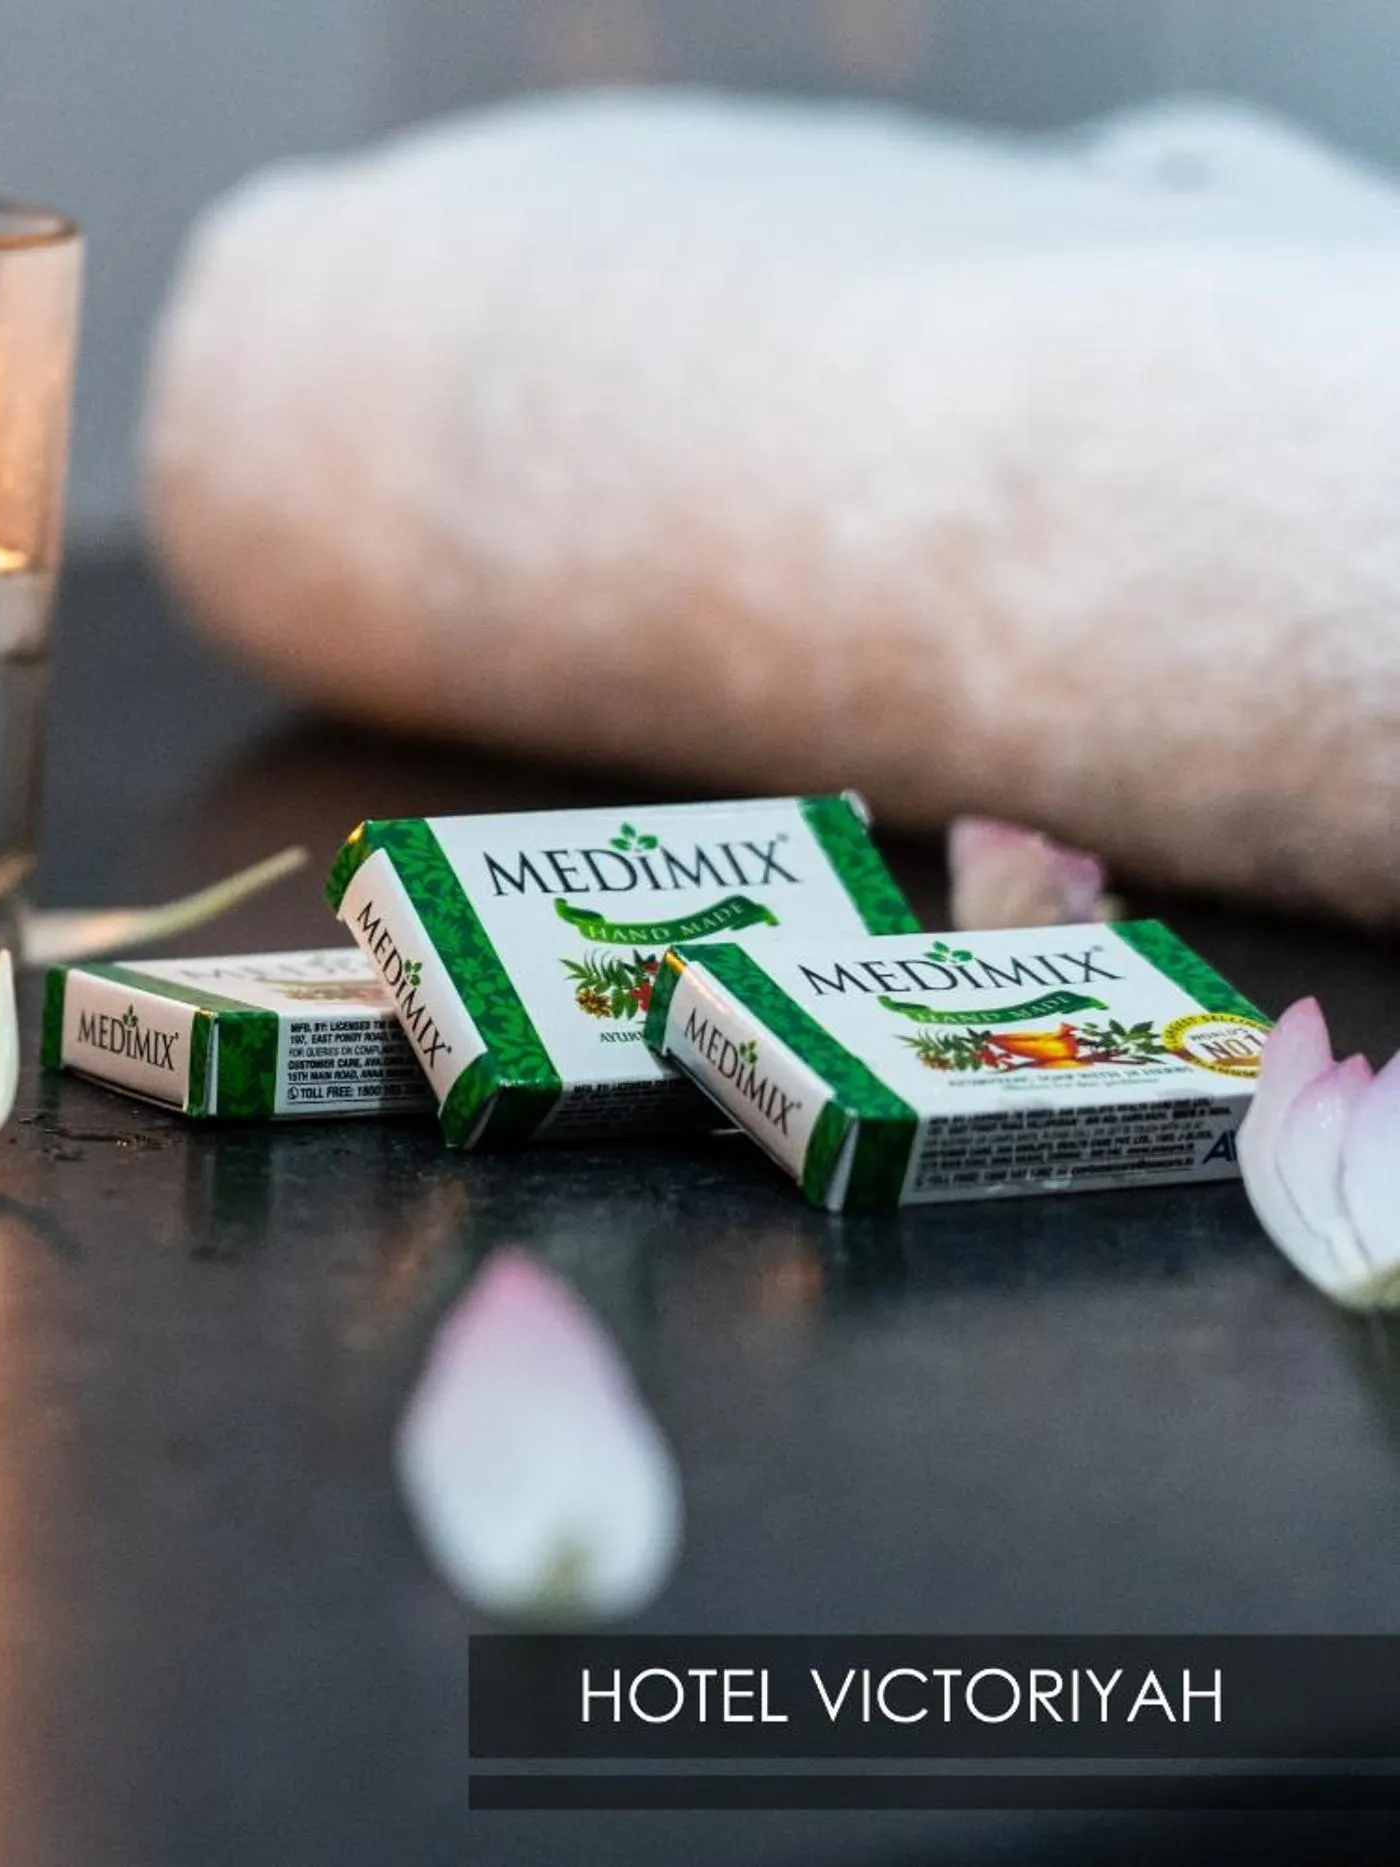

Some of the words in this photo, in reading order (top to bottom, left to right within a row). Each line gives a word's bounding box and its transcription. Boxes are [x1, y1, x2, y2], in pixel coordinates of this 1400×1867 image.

[587, 924, 671, 942] HAND
[679, 901, 745, 938] MADE
[300, 1086, 324, 1099] TOLL
